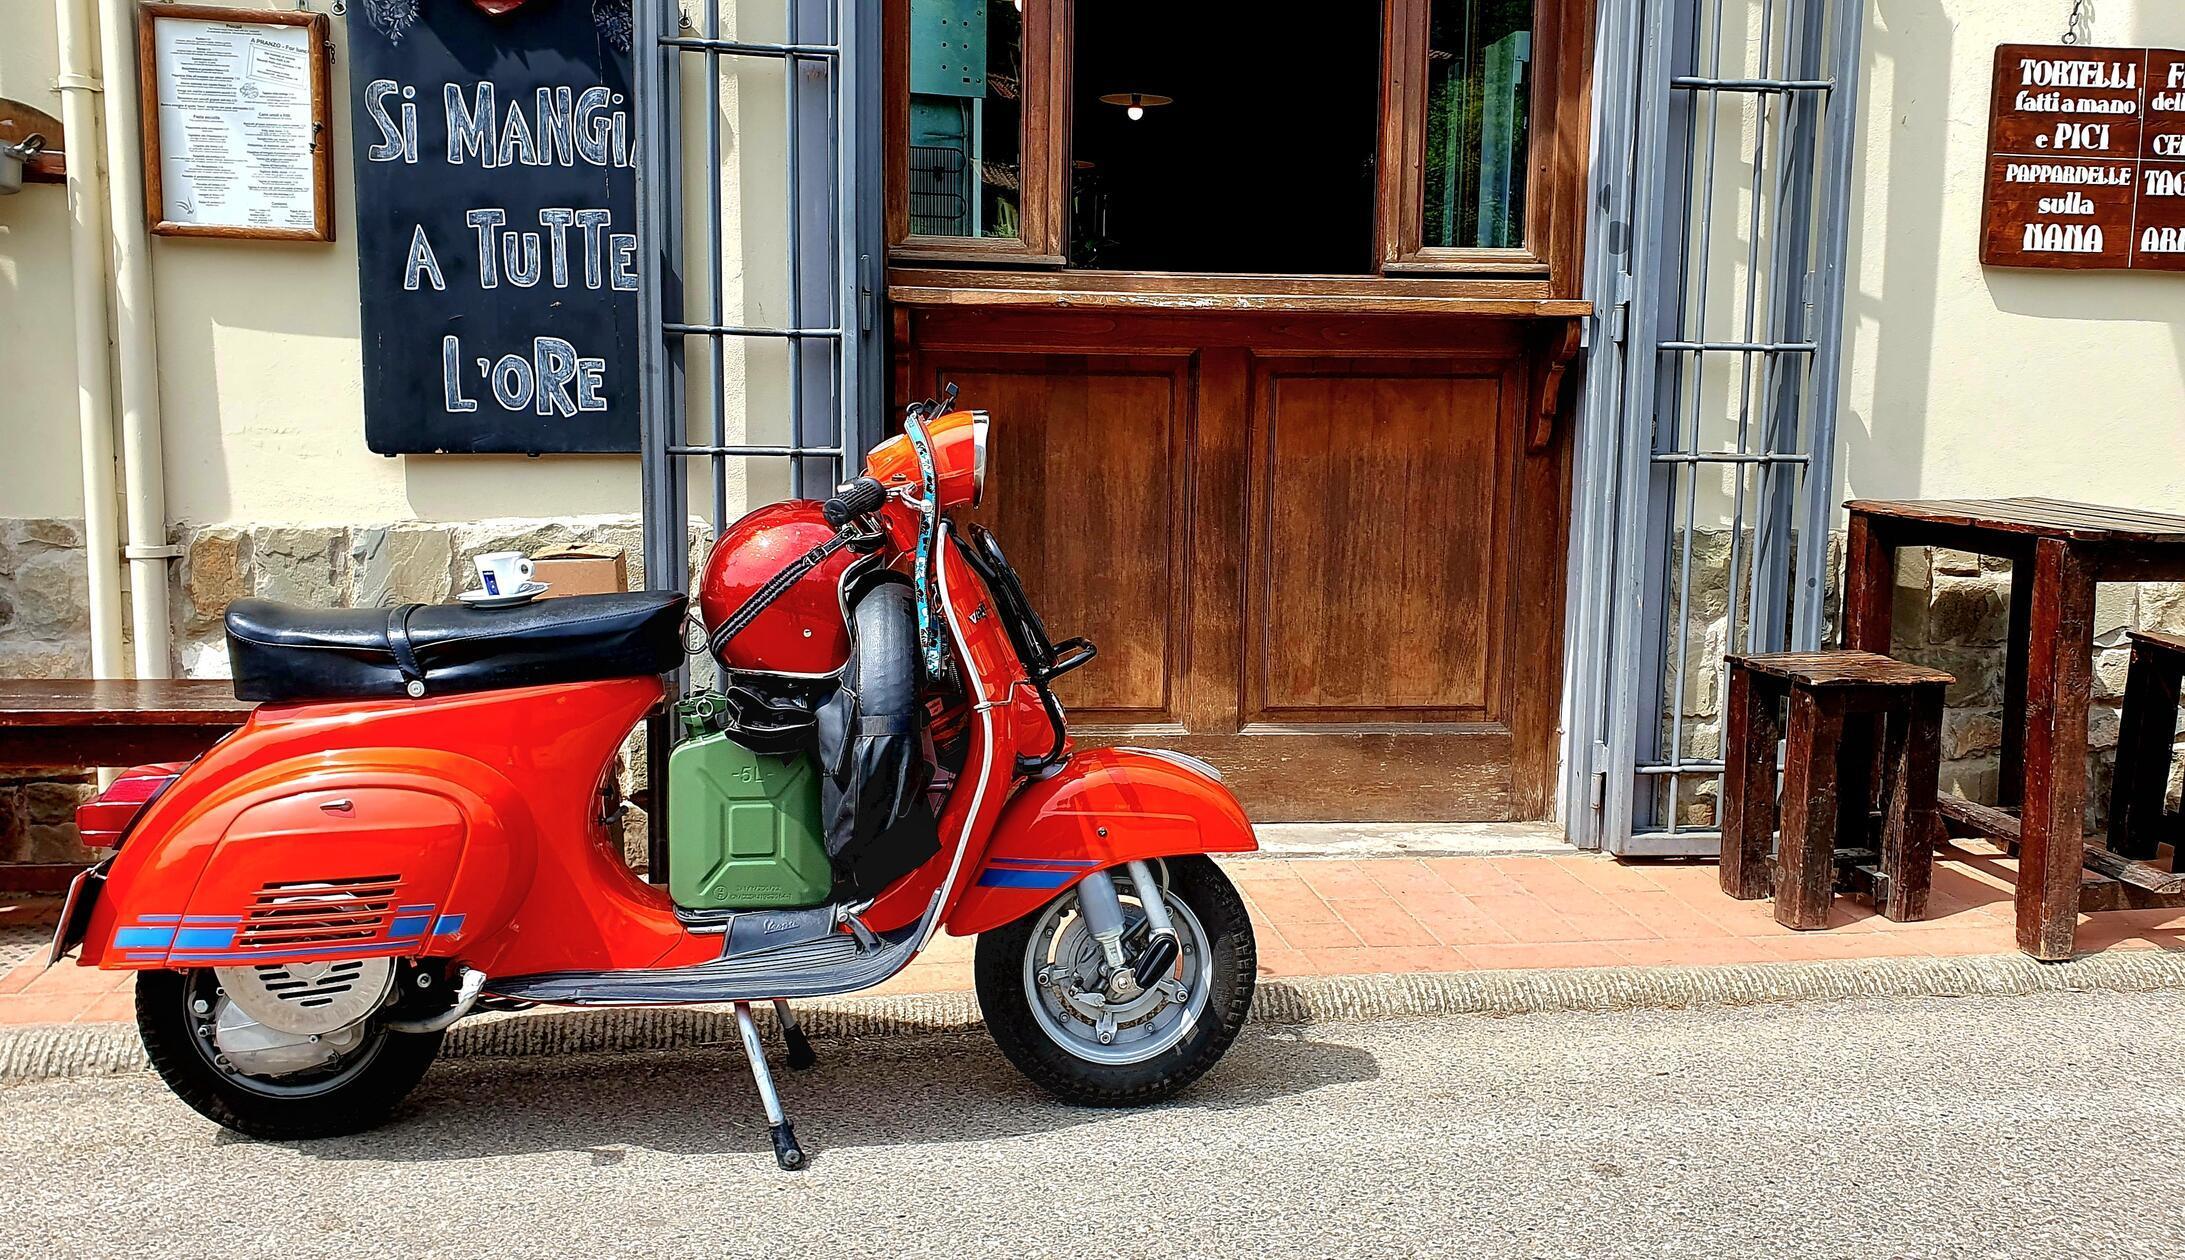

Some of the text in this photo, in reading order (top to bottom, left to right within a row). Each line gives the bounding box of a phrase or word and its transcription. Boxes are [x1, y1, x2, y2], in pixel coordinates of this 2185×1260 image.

[2019, 58, 2137, 90] TORTELLI
[2166, 62, 2185, 89] F
[2015, 90, 2137, 115] fatti a mano
[364, 78, 637, 169] Si MANGi
[2035, 123, 2110, 150] e PICI
[2153, 134, 2185, 156] CE
[2005, 164, 2132, 186] PAPPARDELLE
[2038, 192, 2095, 215] sulla
[2022, 223, 2104, 253] NANA
[403, 223, 446, 291] A
